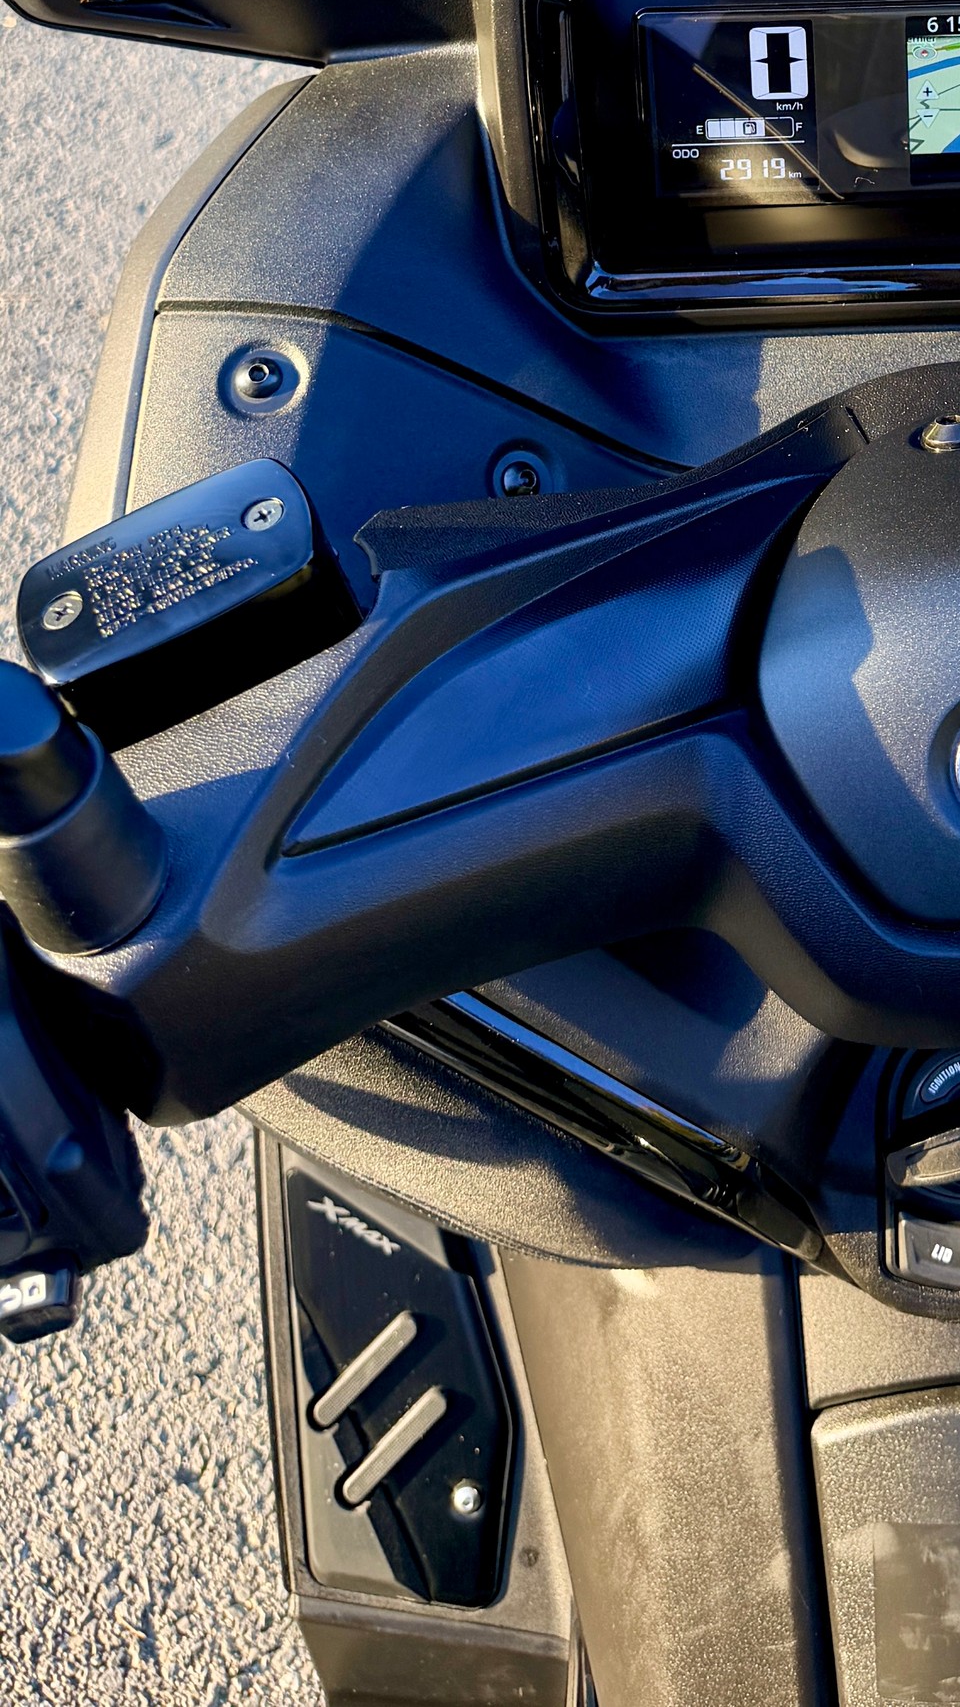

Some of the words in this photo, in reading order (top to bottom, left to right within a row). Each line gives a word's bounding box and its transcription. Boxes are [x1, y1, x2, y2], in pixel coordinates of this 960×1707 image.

[749, 26, 808, 100] 0
[776, 102, 804, 111] km/h
[696, 125, 704, 135] E
[795, 122, 803, 132] F
[672, 148, 699, 159] ODO
[720, 157, 786, 181] 2919
[788, 170, 802, 179] km
[931, 1243, 953, 1264] LID
